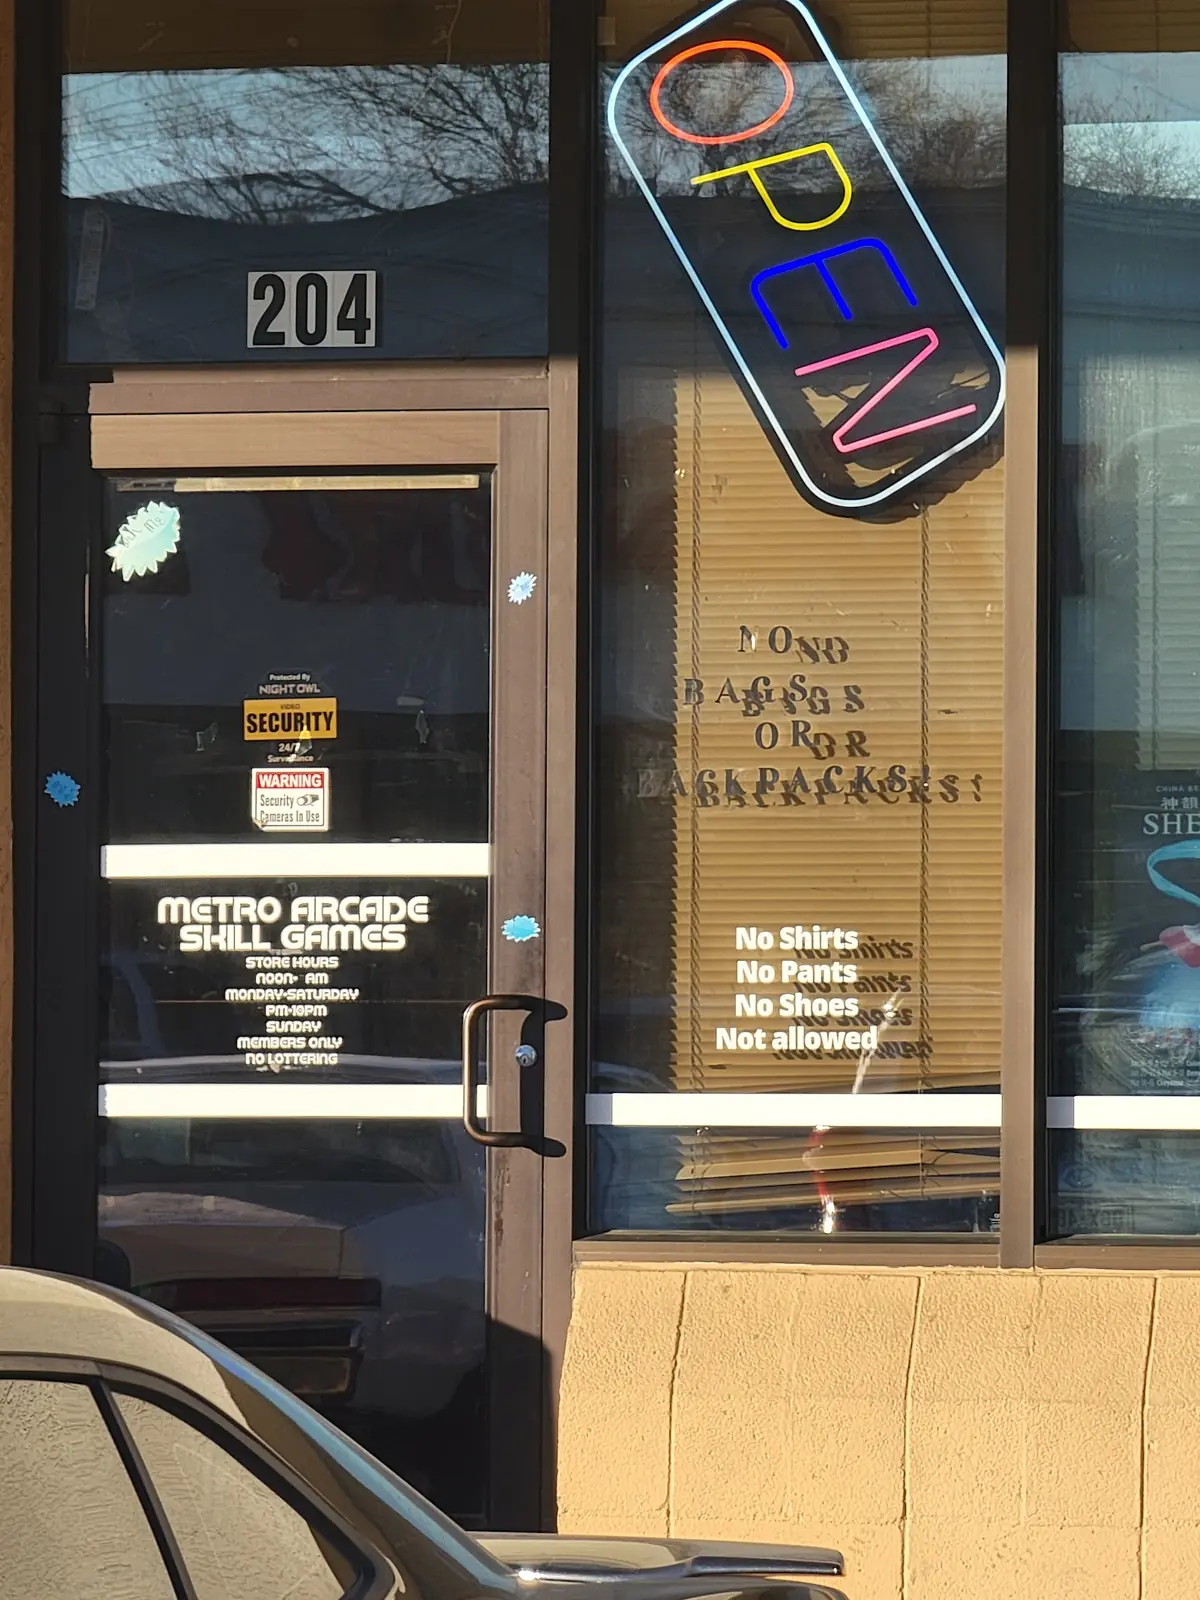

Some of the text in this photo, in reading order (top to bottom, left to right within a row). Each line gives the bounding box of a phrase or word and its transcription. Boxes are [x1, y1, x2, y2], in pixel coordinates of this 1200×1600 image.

[650, 40, 977, 452] OPEN
[252, 273, 371, 346] 204
[738, 625, 792, 653] NO
[269, 673, 311, 681] Protected By
[259, 683, 320, 694] NIGHT OWL
[683, 674, 808, 706] BAGS
[247, 711, 334, 733] SECURITY
[755, 720, 815, 750] OR
[278, 742, 300, 752] 24/7
[259, 774, 322, 788] WARNING
[260, 794, 294, 808] Security
[260, 810, 320, 822] Cameras In Use
[157, 896, 429, 924] METRO ARCADE
[179, 924, 406, 951] SKILL GAMES
[735, 925, 858, 950] No Shirts
[245, 956, 339, 969] STORE HOURS
[737, 960, 857, 983] No Pants
[305, 972, 329, 985] AM
[225, 988, 360, 1001] MONDAY-SATURDAY
[735, 993, 859, 1017] No Shoes
[266, 1020, 321, 1033] SUNDAY
[237, 1036, 343, 1049] MEMBERS ONLY
[716, 1026, 878, 1050] Not allowed
[245, 1053, 265, 1065] NO
